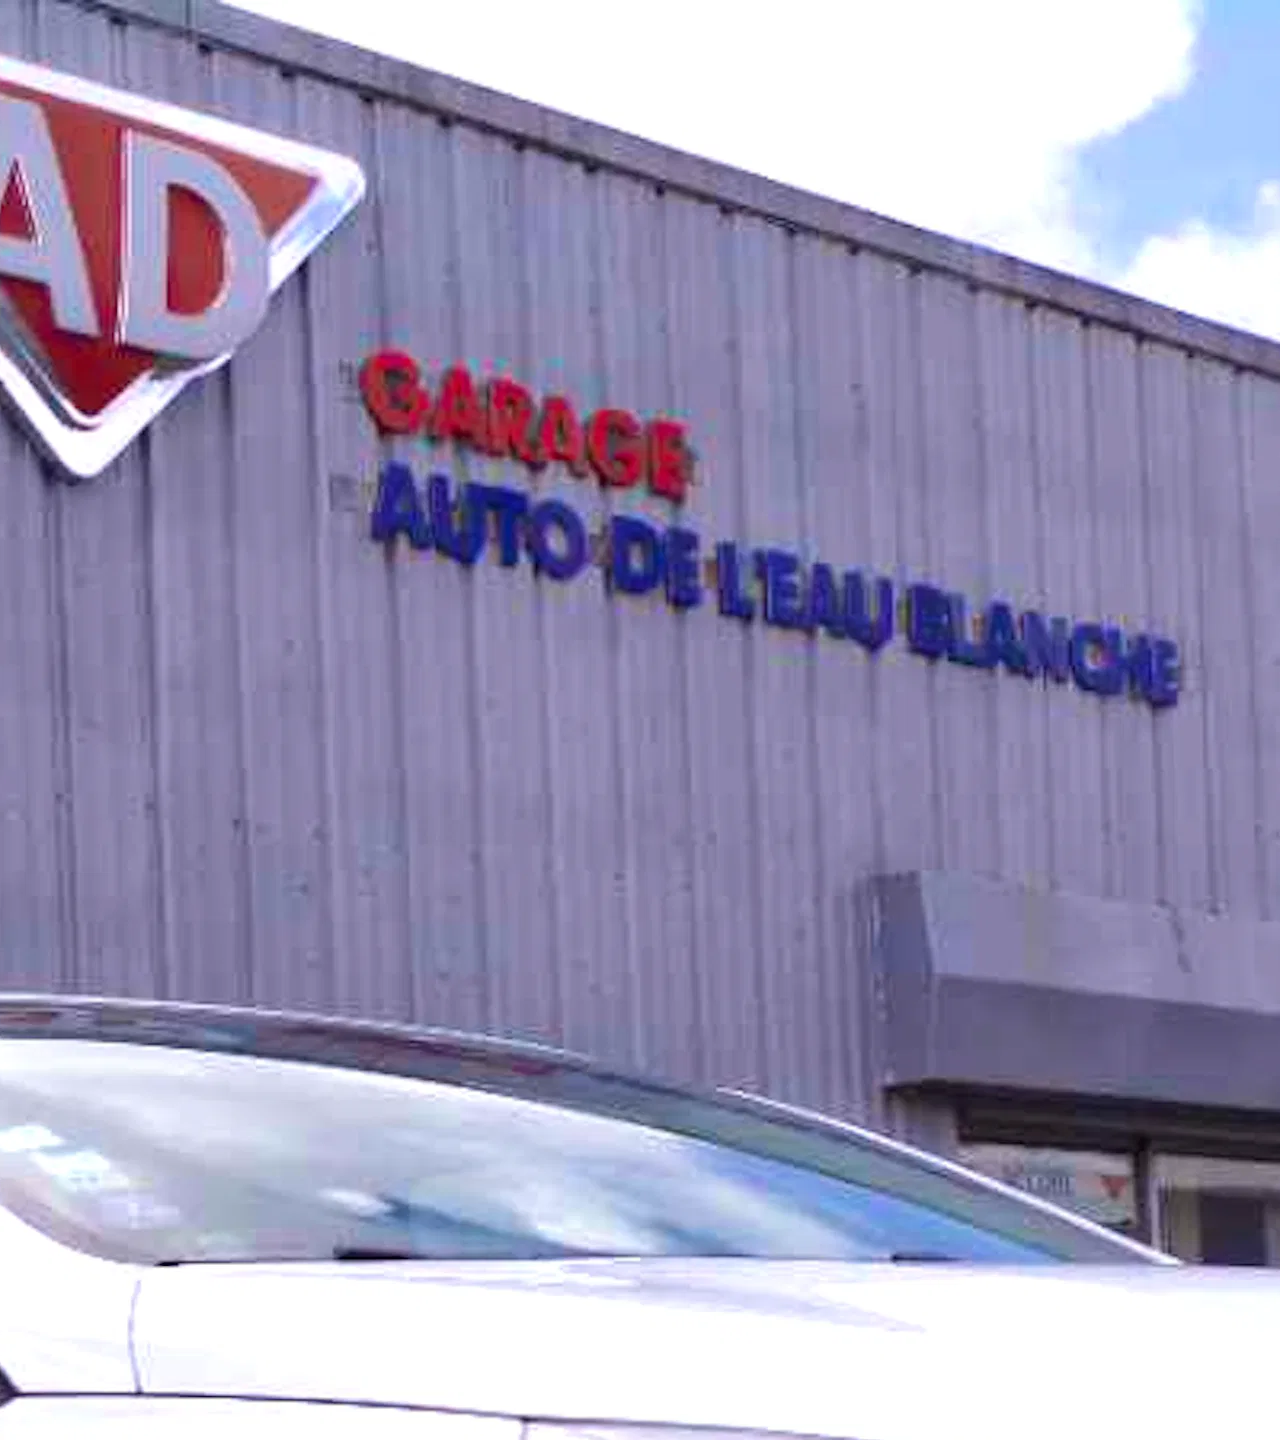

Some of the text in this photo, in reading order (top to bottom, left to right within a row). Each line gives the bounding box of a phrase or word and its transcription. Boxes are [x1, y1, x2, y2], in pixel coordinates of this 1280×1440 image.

[359, 349, 688, 501] GARAGE
[372, 455, 1180, 708] AUTO DE L'EAU BLANCHE
